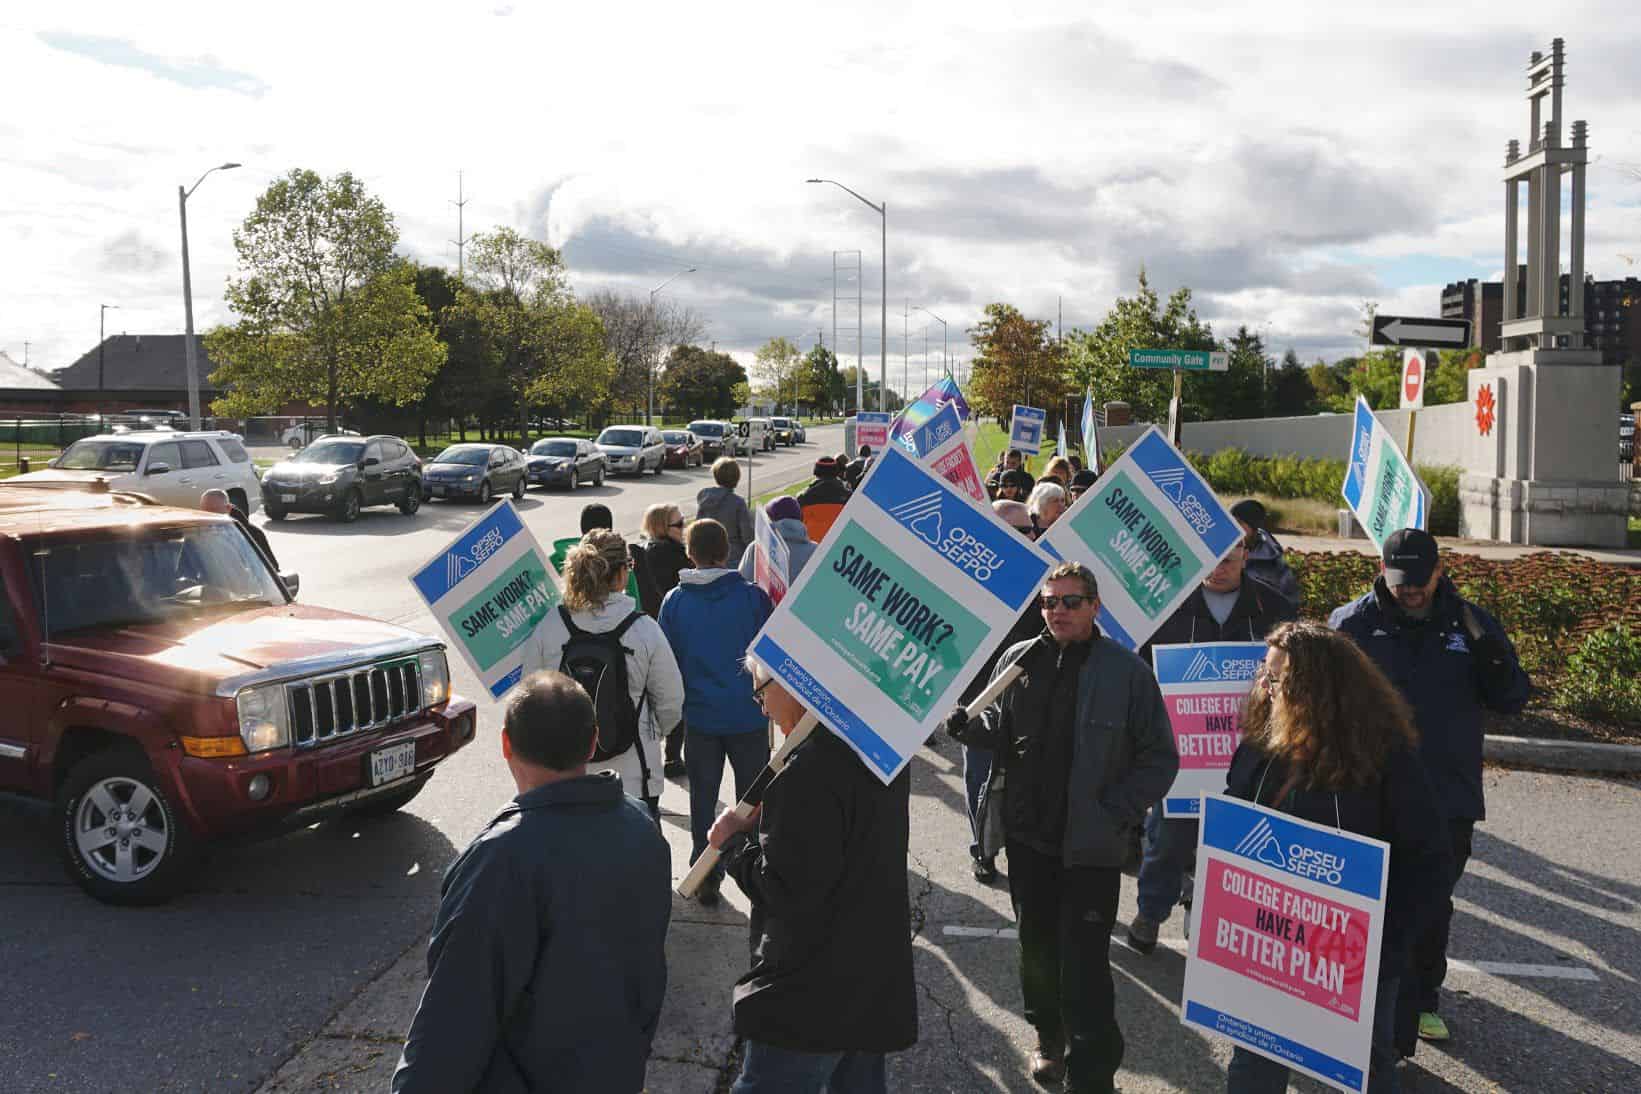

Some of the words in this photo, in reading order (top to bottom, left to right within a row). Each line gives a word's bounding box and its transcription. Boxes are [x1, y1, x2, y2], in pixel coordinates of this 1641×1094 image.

[1134, 353, 1182, 366] Community
[1183, 354, 1204, 366] Gate
[1104, 487, 1146, 532] SAME
[1140, 521, 1182, 574] WORK?
[1178, 500, 1208, 536] SEFPO
[1186, 493, 1217, 530] OPSEU
[470, 526, 501, 556] OPSEU
[474, 535, 504, 564] SEFPO
[949, 527, 1005, 570] OPSEU
[938, 541, 992, 582] SEFPO
[1109, 529, 1149, 575] SAME
[1139, 561, 1172, 603] PAY.
[461, 595, 498, 638] SAME
[492, 569, 531, 611] WORK?
[495, 600, 532, 639] SAME
[525, 581, 556, 616] PAY.
[832, 544, 892, 603] SAME
[882, 586, 954, 652] WORK?
[844, 601, 905, 661] SAME
[893, 640, 945, 696] PAY.
[1176, 697, 1222, 715] COLLEGE
[1205, 716, 1233, 731] HAVE
[1178, 734, 1234, 757] BETTER
[1287, 858, 1342, 885] SEFPO
[1288, 843, 1345, 871] OPSEU
[1222, 867, 1281, 911] COLLEGE
[1282, 890, 1351, 935] FACULTY
[1255, 907, 1293, 942] HAVE
[1294, 923, 1306, 945] A
[1215, 916, 1285, 973] BETTER
[1289, 946, 1346, 995] PLAN
